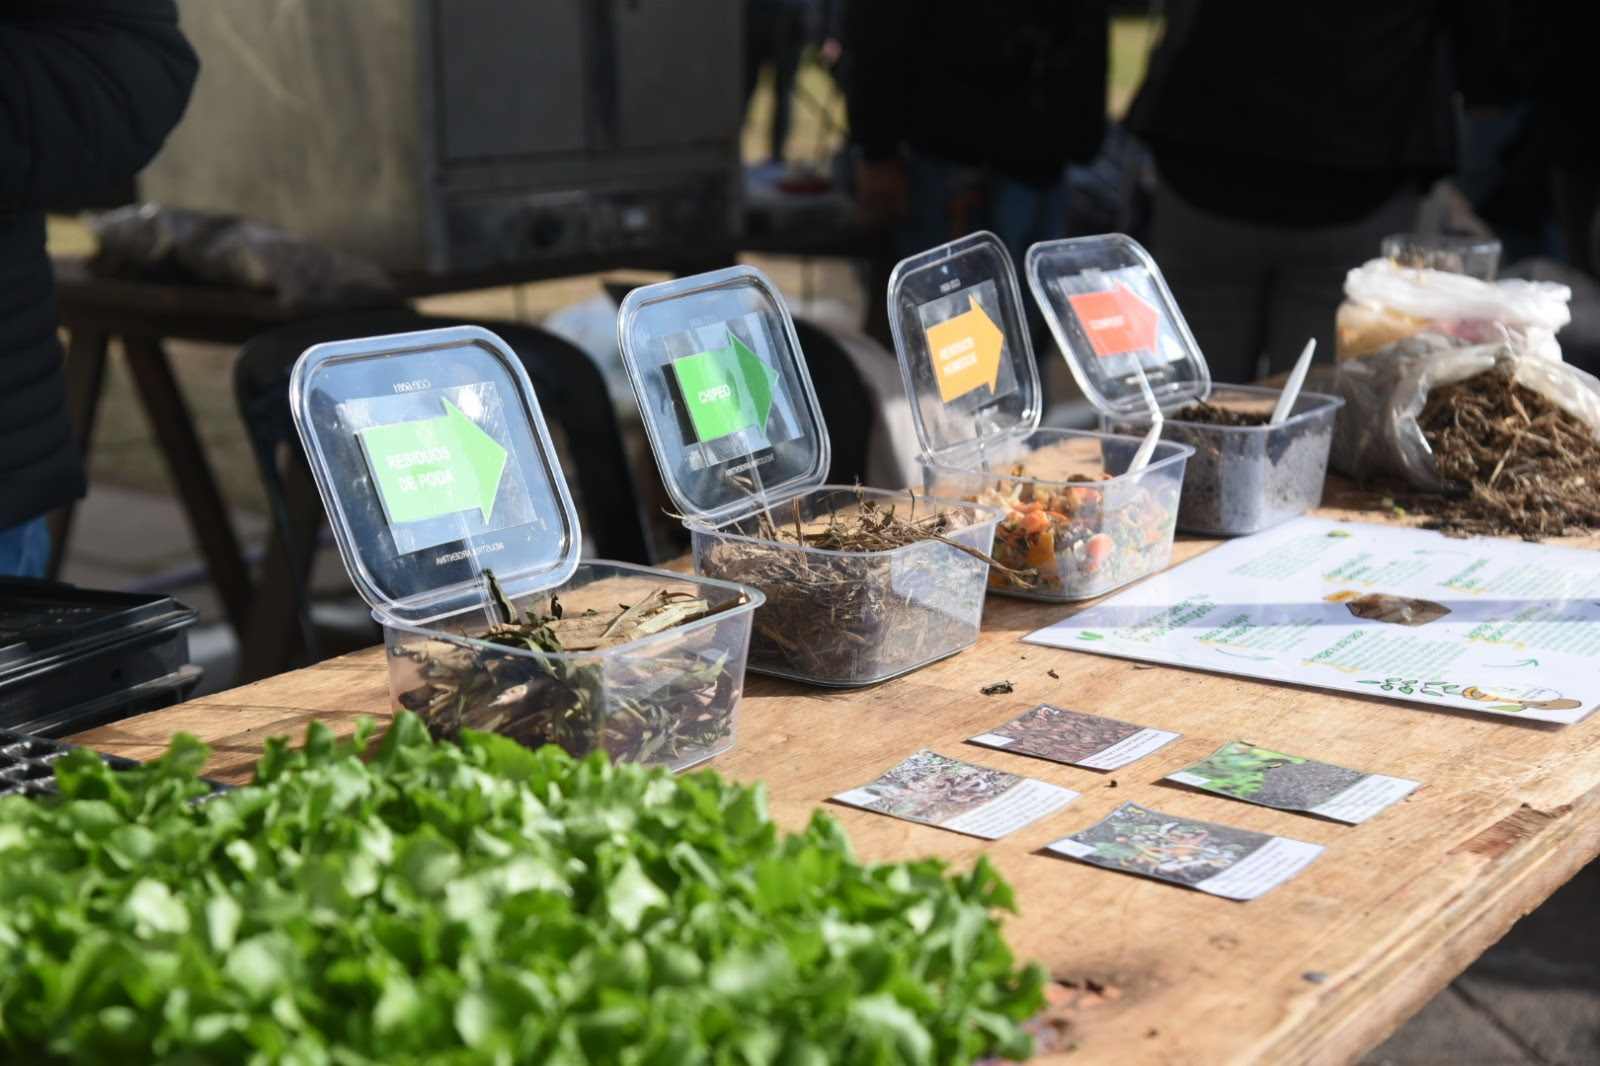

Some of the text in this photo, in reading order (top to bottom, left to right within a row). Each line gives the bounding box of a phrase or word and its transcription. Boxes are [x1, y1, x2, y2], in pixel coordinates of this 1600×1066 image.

[697, 384, 731, 404] CHIPEO
[386, 446, 451, 471] RESIDUOS
[400, 469, 455, 493] DE PODA
